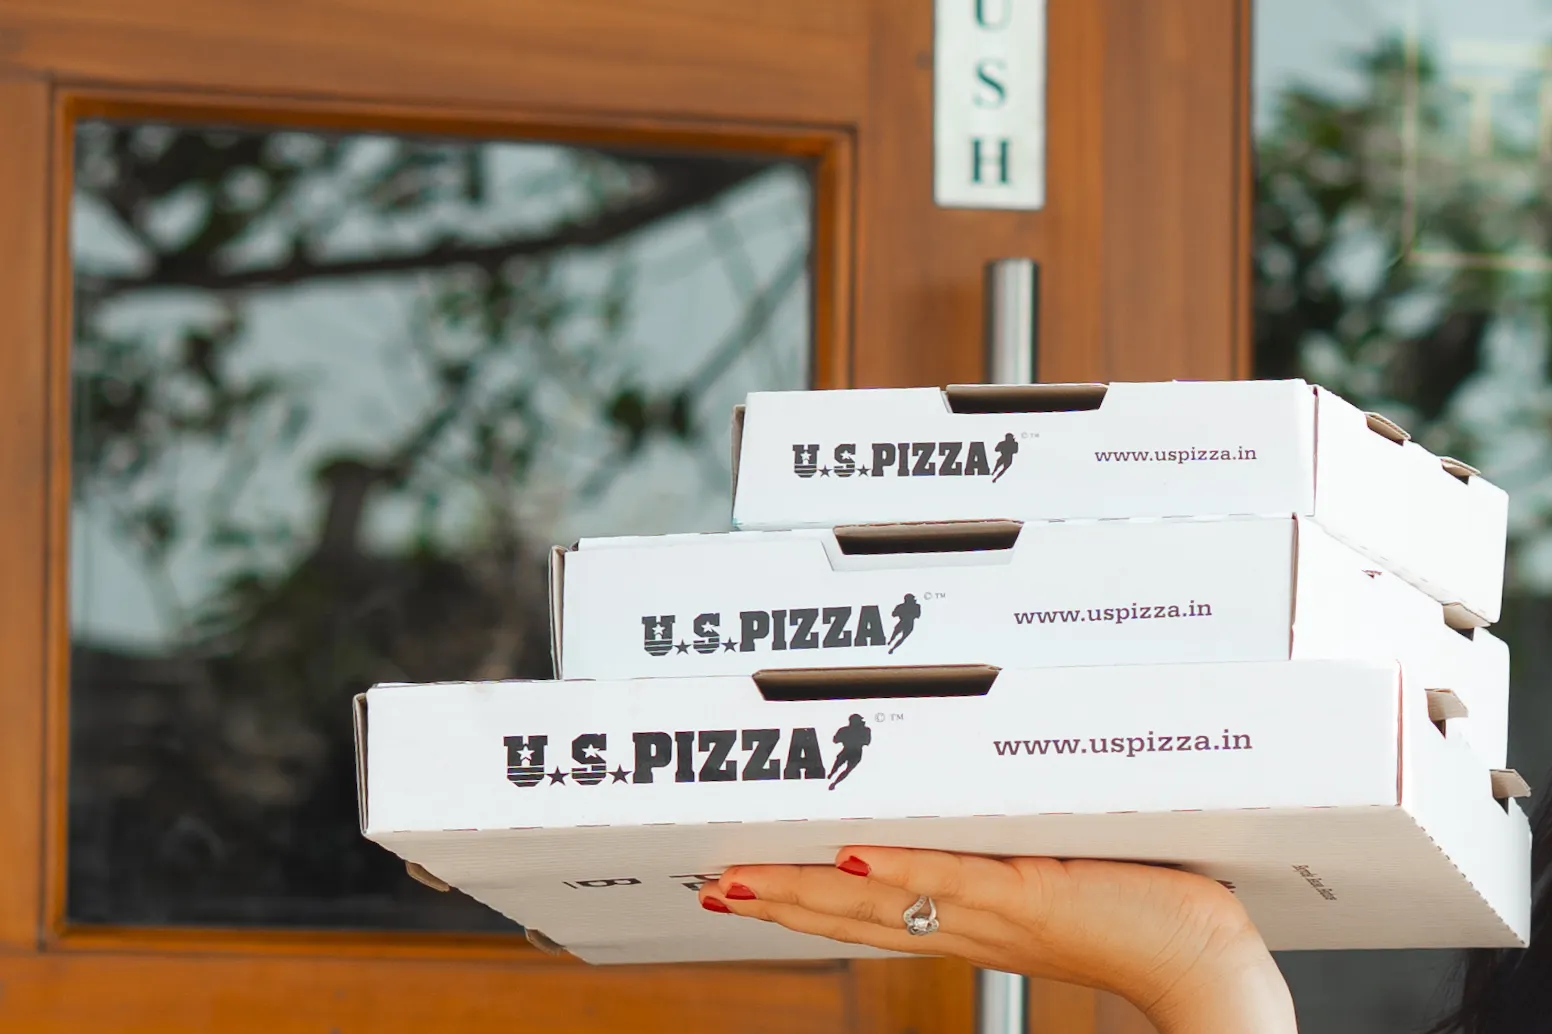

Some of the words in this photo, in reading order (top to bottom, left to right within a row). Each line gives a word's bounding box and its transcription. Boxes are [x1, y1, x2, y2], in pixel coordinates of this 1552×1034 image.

[1094, 446, 1257, 464] www.uspizza.in
[1014, 600, 1212, 624] www.uspizza.in
[993, 729, 1253, 757] www.uspizza.in
